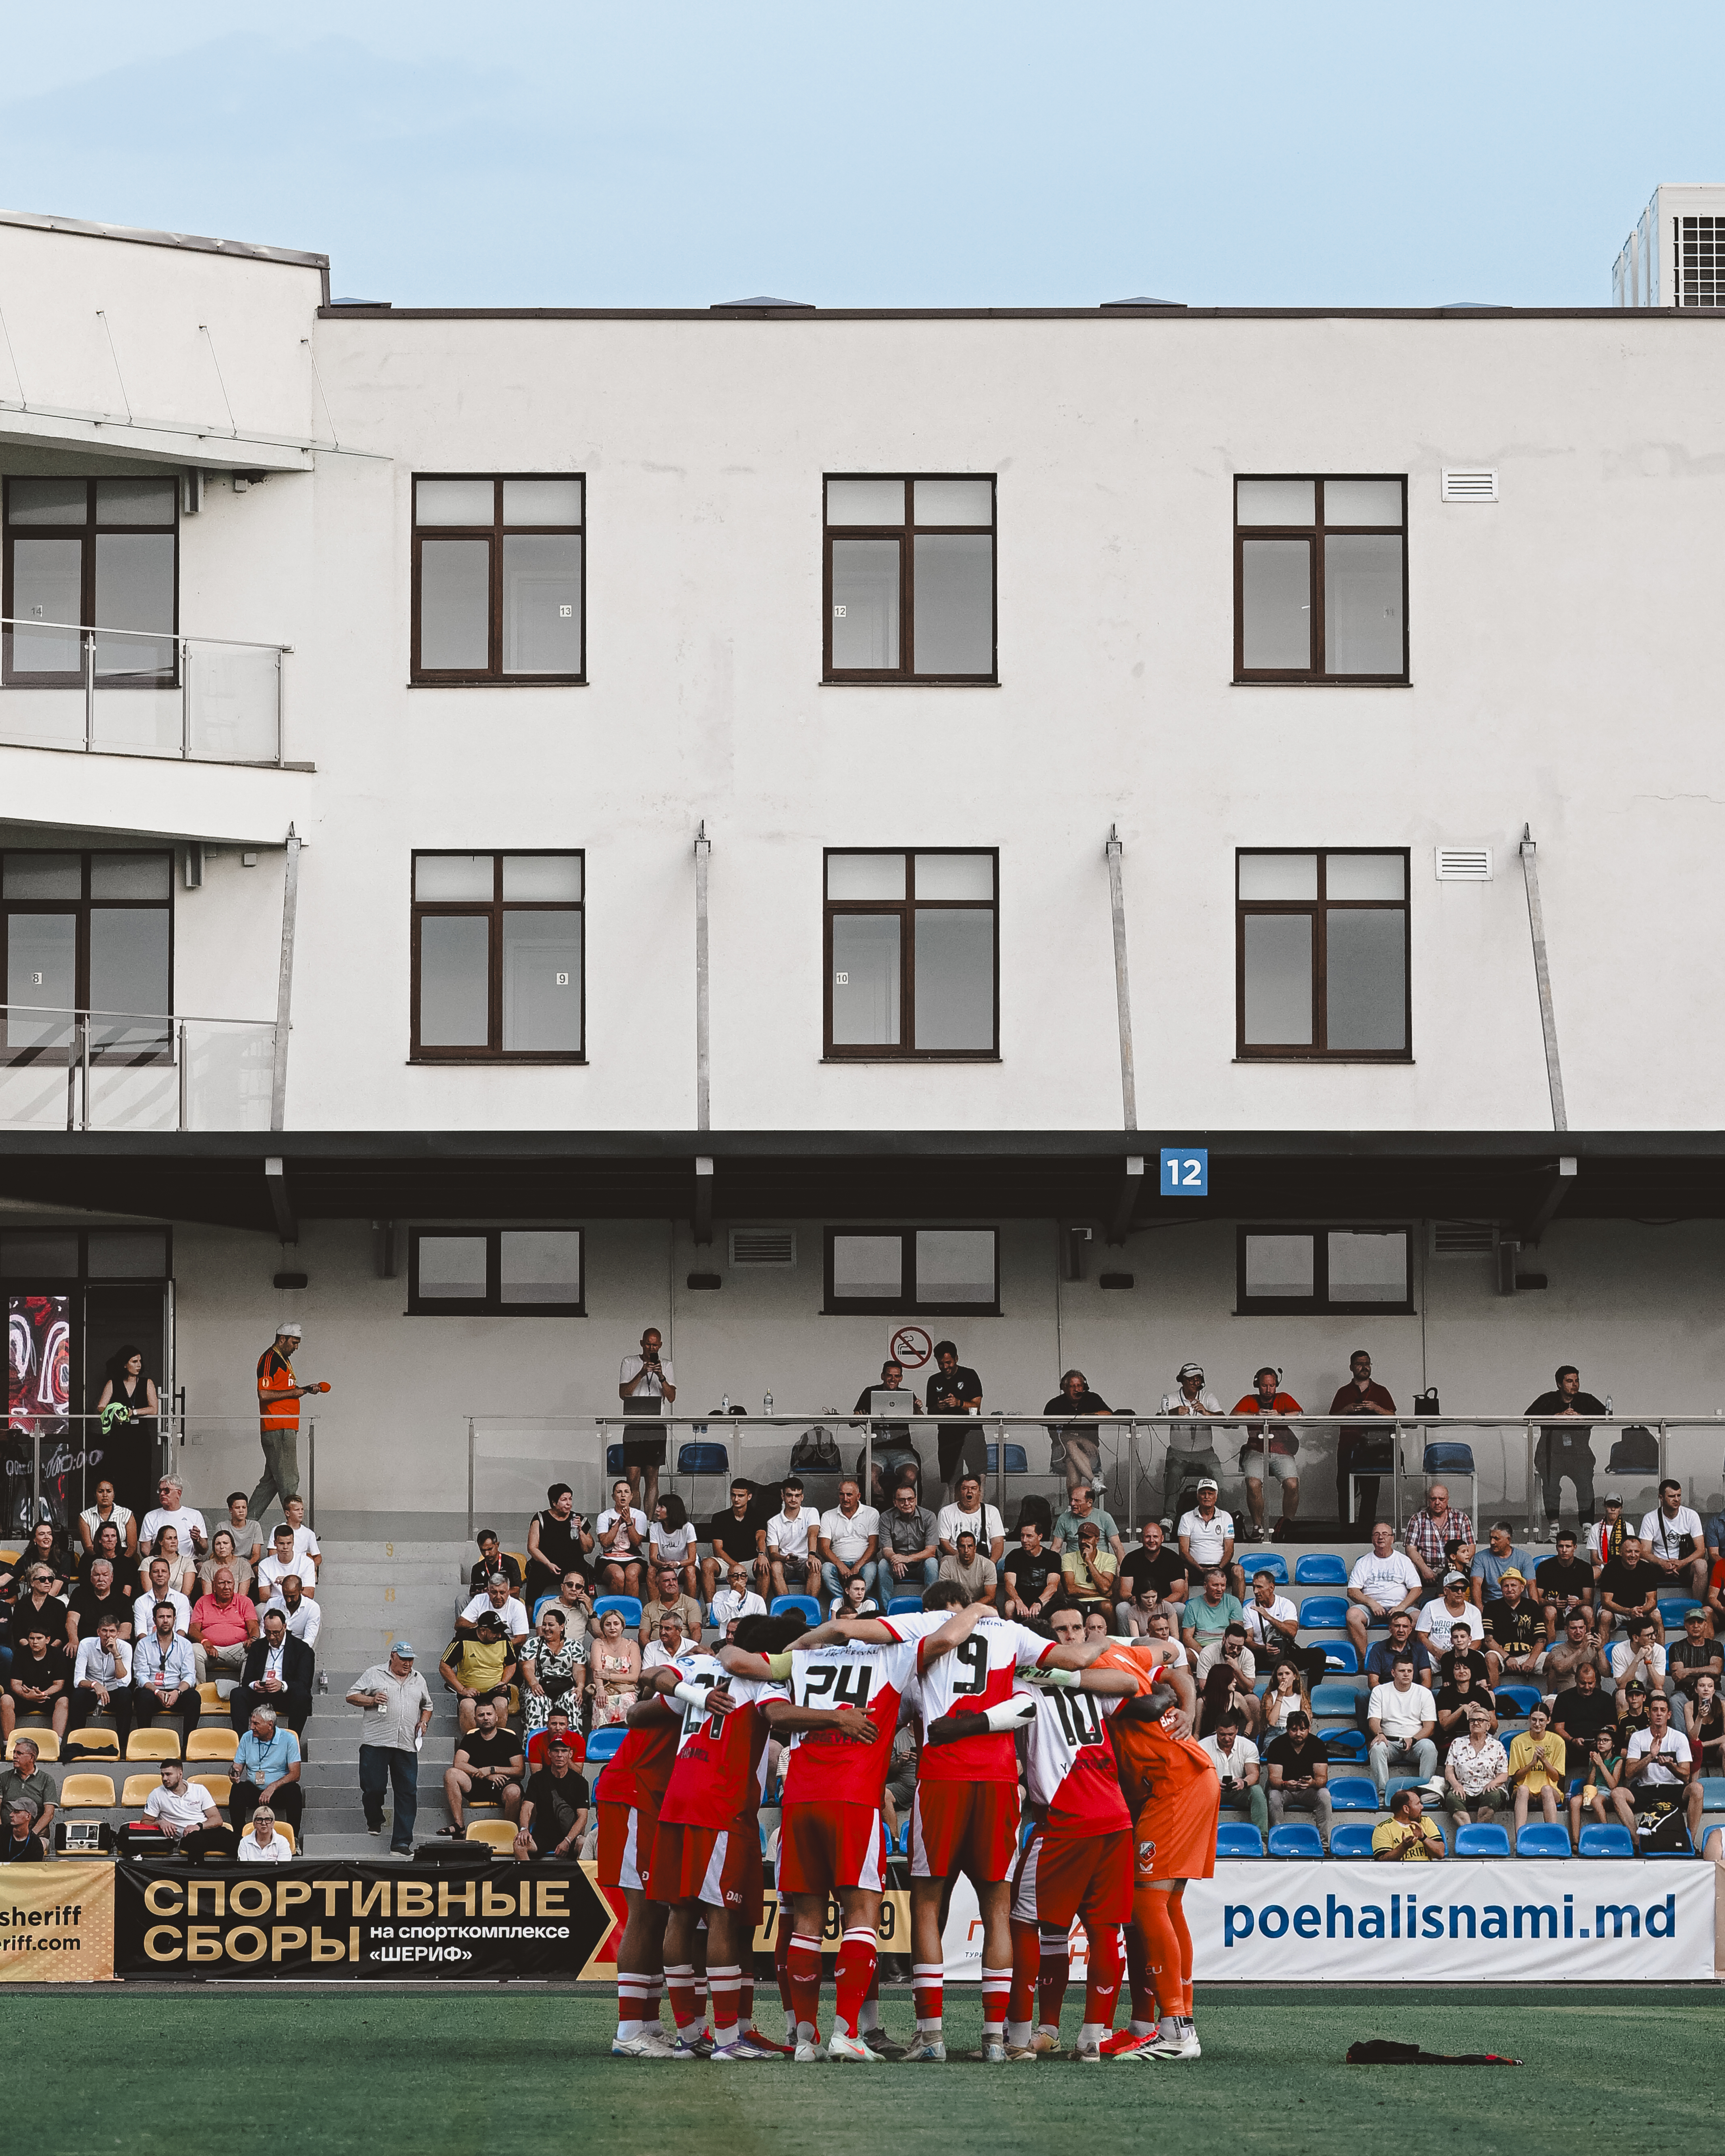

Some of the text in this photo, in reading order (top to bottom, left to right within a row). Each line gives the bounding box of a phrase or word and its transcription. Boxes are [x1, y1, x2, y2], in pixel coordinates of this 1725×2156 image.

[33, 974, 39, 983] 8
[560, 974, 566, 983] 9
[837, 974, 847, 982] 10
[1167, 1159, 1202, 1185] 12
[386, 1543, 394, 1557] 9
[385, 1632, 394, 1646] 7
[953, 1633, 988, 1694] 9
[1039, 1686, 1105, 1747] 10
[144, 1880, 570, 1917] СПОРТИВНЫЕ
[0, 1905, 82, 1926] sheriff
[1224, 1894, 1676, 1947] poehalisnami.md
[370, 1926, 570, 1941] на спорткомплексе
[0, 1935, 80, 1951] riff.com
[144, 1925, 359, 1961] СБОРЫ
[370, 1946, 473, 1962] «ШЕРИФ»
